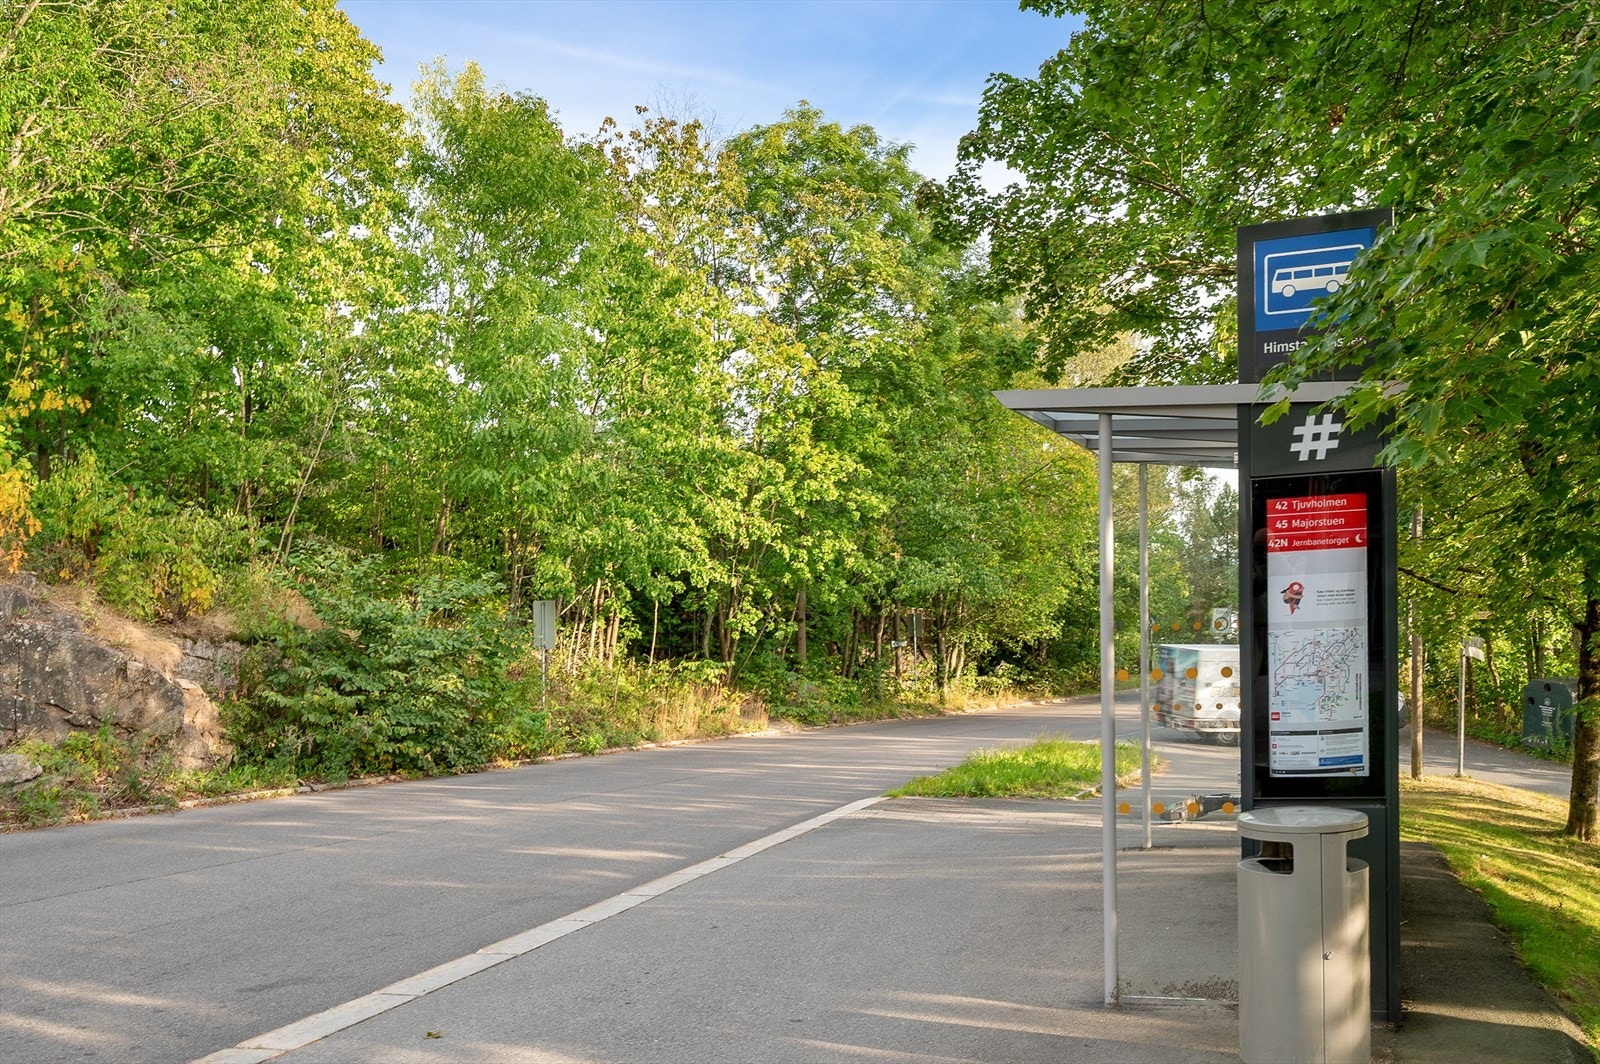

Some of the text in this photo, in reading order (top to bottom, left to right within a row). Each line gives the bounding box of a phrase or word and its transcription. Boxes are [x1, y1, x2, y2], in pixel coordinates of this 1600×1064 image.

[1275, 498, 1347, 511] 42 Tjuvholmen
[1275, 517, 1345, 529] 45 Majorstuen
[1268, 537, 1349, 548] 42N Jernbanetorget
